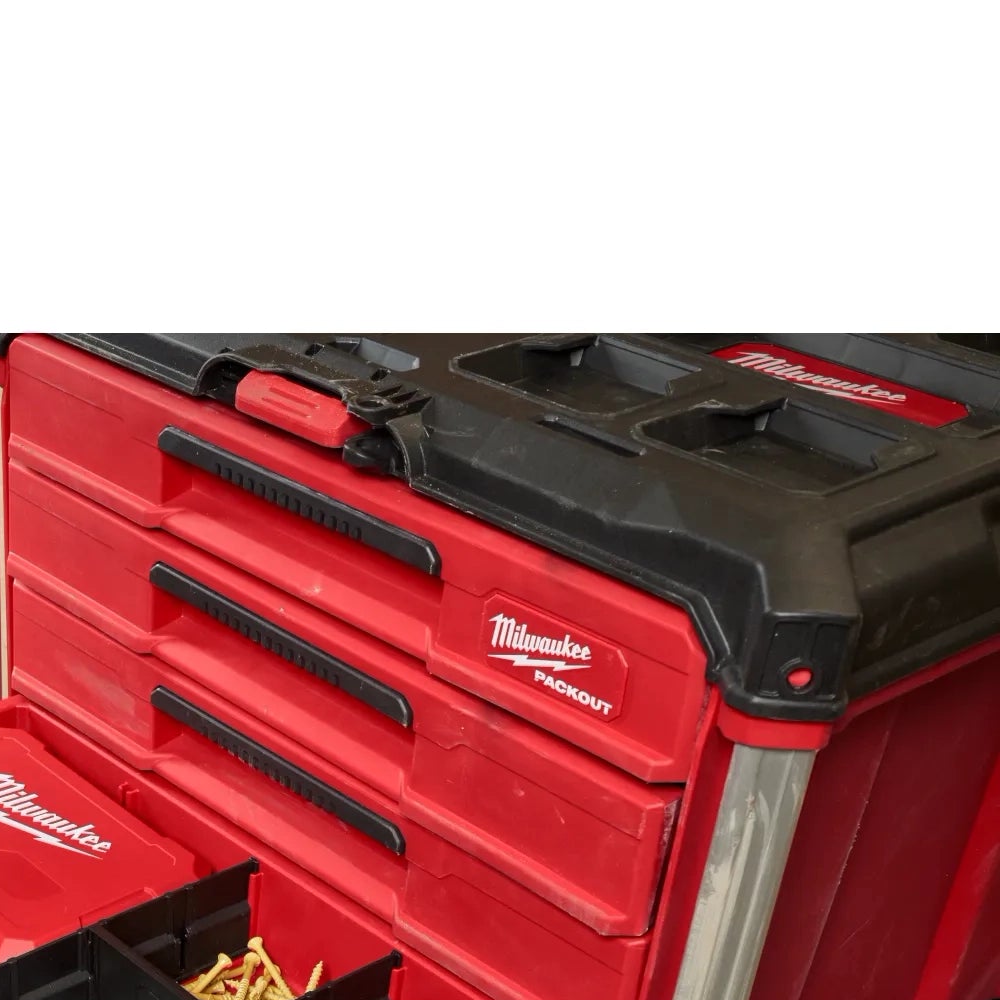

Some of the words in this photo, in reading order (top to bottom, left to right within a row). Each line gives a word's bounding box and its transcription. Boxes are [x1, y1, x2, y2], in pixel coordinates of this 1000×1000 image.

[728, 352, 906, 402] Milwaukee
[488, 613, 592, 661] Milwaukee
[534, 669, 613, 716] PACKOUT
